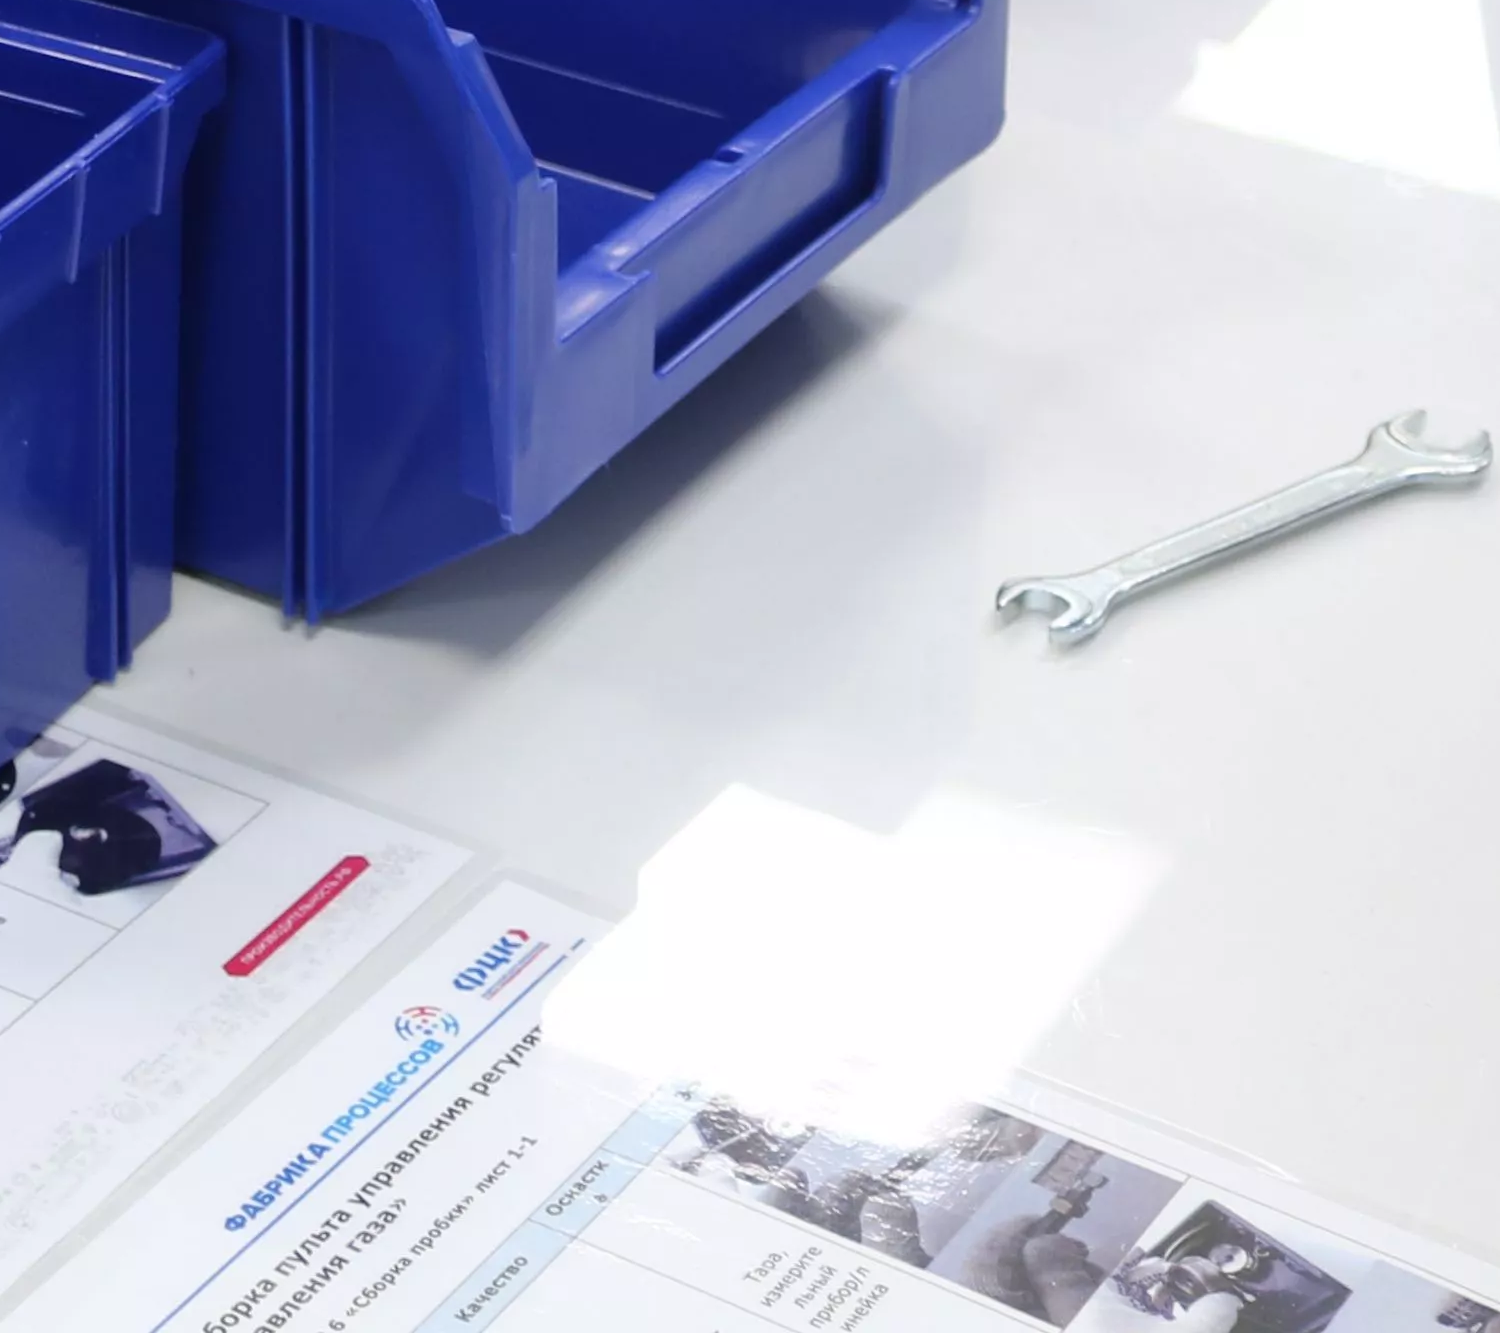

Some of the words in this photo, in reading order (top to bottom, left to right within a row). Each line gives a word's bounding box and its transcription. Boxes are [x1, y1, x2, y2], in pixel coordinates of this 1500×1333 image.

[223, 1140, 332, 1234] ФАБРИКА
[319, 1037, 445, 1145] ПРОЦЕССОВ
[203, 1277, 279, 1333] борка
[273, 1206, 353, 1278] пульта
[346, 1095, 475, 1210] управления
[468, 1024, 545, 1099] регулят
[544, 1158, 610, 1218] Оснастк
[253, 1253, 351, 1333] авления
[347, 1196, 409, 1256] газа»
[328, 1318, 346, 1333] 6
[345, 1255, 413, 1319] «Сборка
[408, 1194, 476, 1258] пробки»
[474, 1158, 512, 1195] лист
[506, 1133, 539, 1162] 1-1
[454, 1255, 530, 1324] Качество
[742, 1249, 791, 1285] Тара,
[759, 1244, 824, 1310] измерите
[792, 1264, 840, 1311] льный
[808, 1264, 872, 1331] прибор/л
[839, 1281, 891, 1333] инейка
